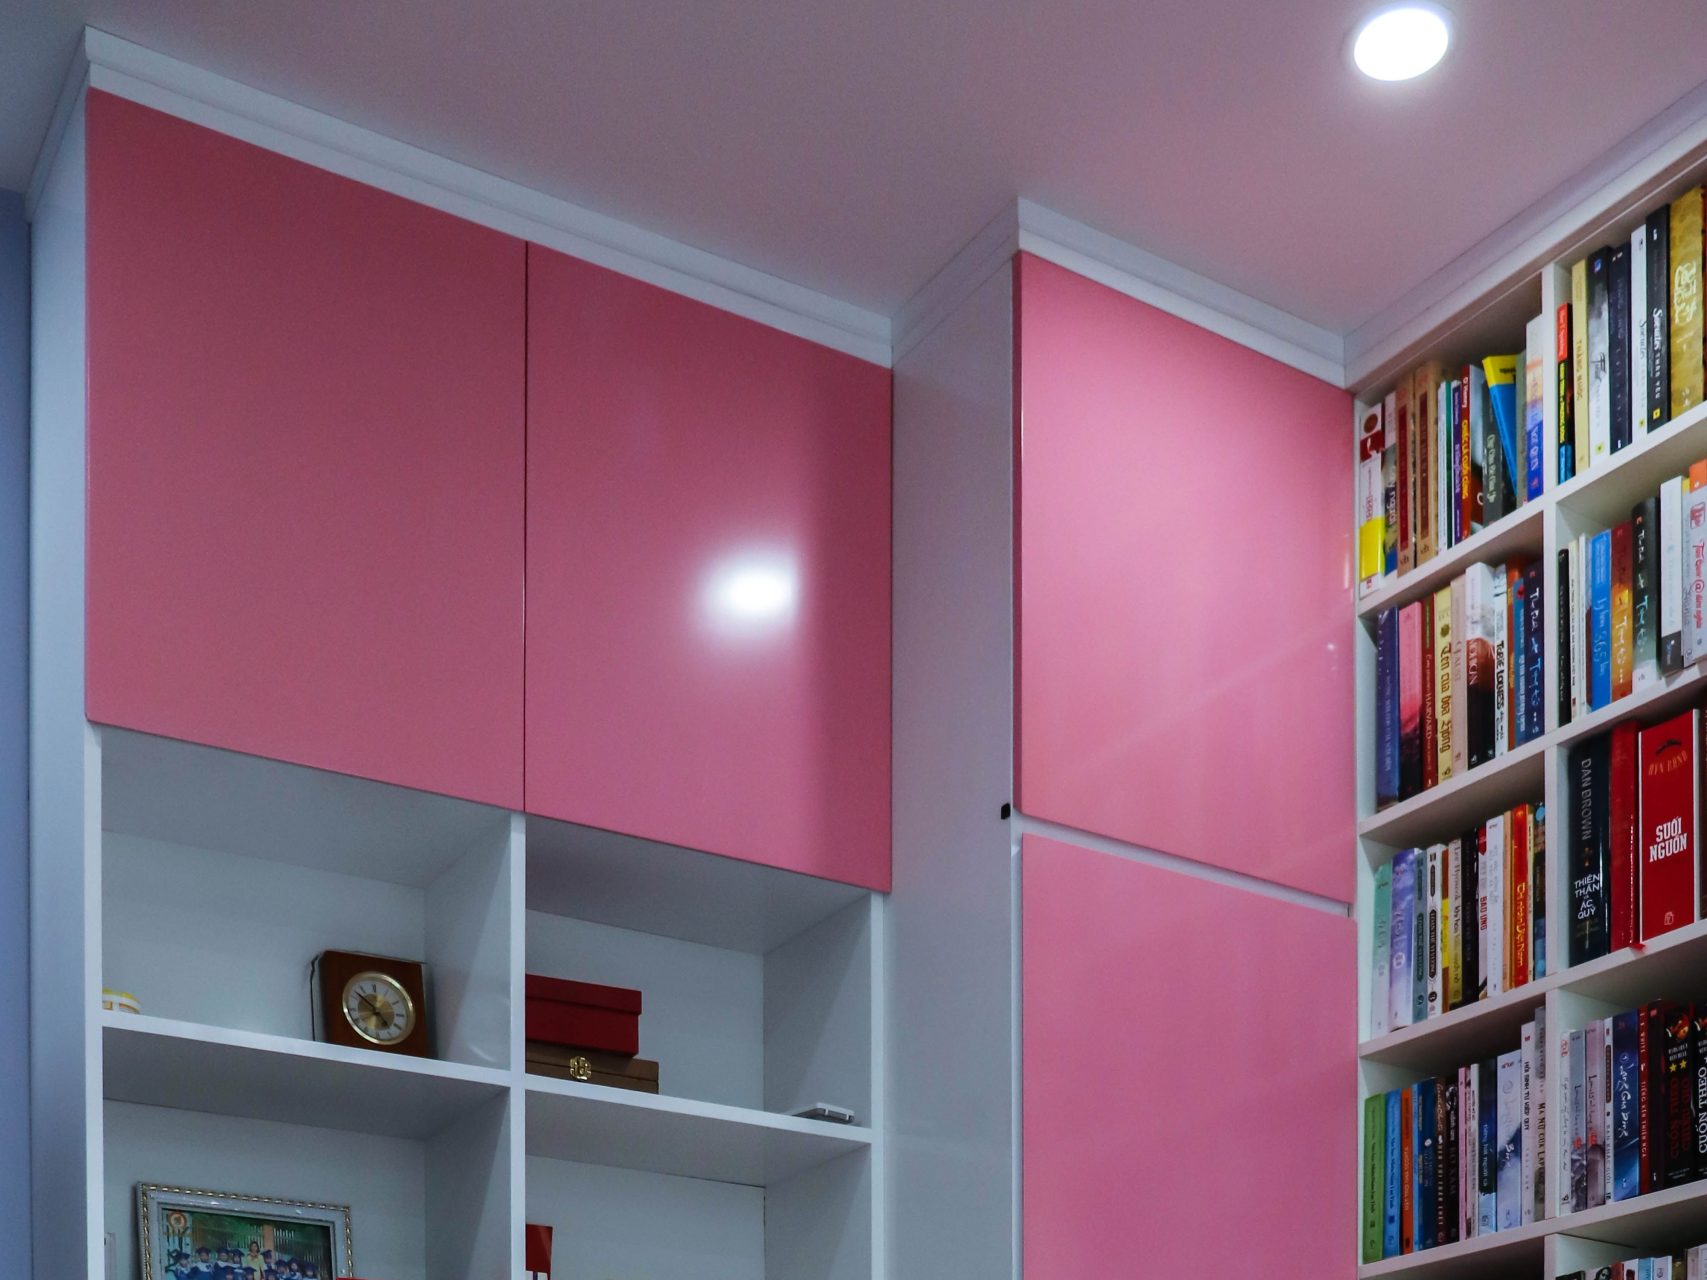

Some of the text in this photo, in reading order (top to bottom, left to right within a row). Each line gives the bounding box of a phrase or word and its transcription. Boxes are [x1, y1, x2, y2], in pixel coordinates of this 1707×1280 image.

[1496, 640, 1505, 669] TOBIE
[1594, 631, 1606, 662] 365
[1581, 758, 1592, 841] DAN BROWN
[1655, 817, 1683, 843] SUỐI
[1649, 833, 1687, 863] NGUỒN
[1574, 873, 1600, 889] THIÊN
[1574, 882, 1600, 898] THẦN
[1580, 897, 1593, 911] ÁC
[1696, 1067, 1707, 1153] CUỐN THEO
